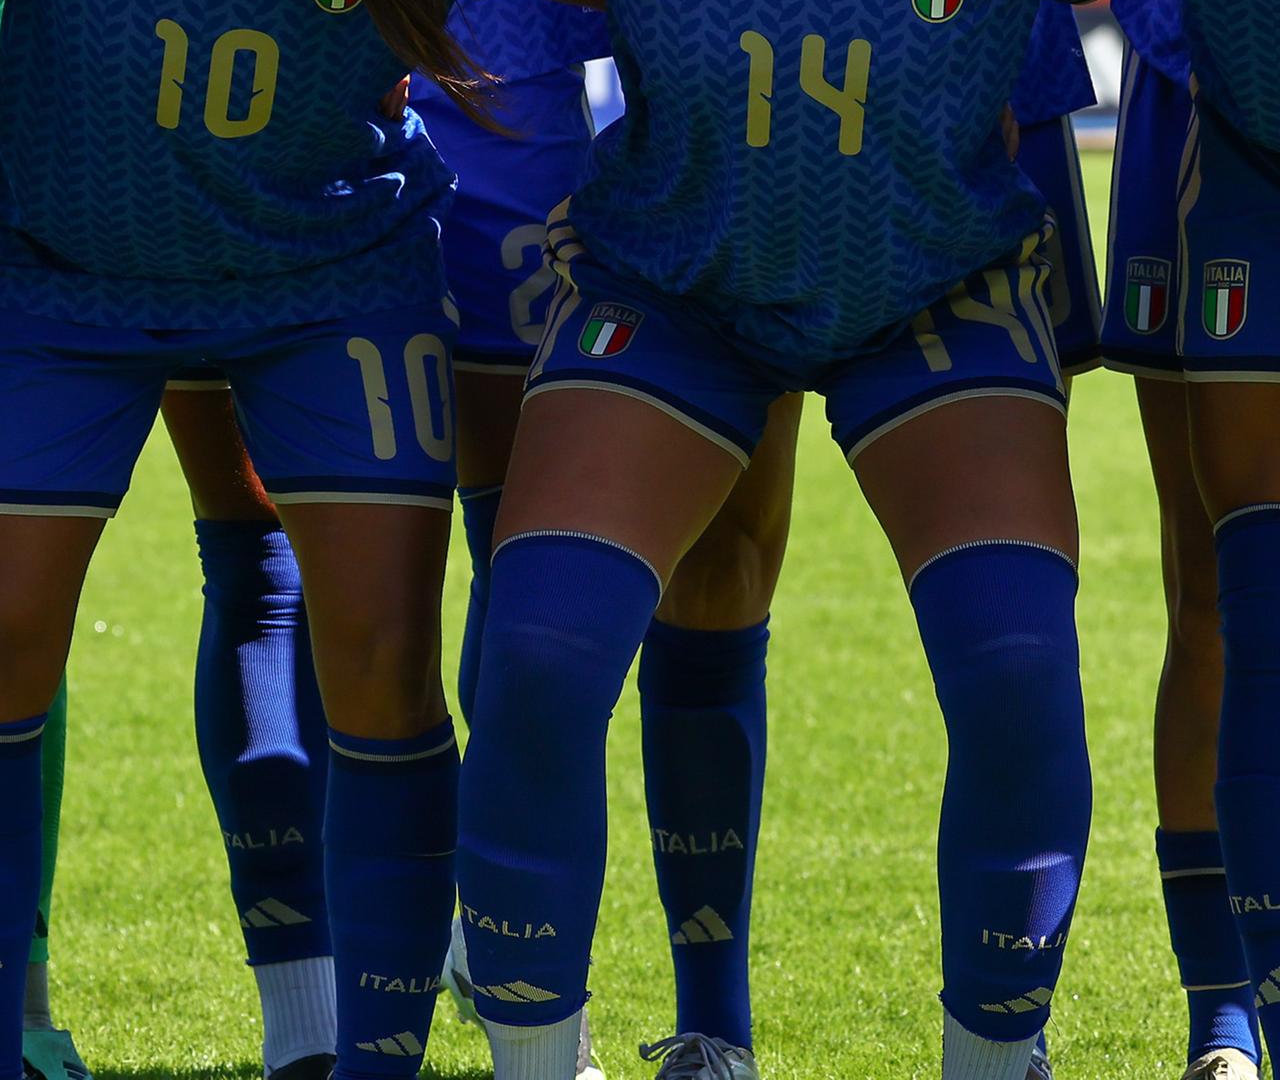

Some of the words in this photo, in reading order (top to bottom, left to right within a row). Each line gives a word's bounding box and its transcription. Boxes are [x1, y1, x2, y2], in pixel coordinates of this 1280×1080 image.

[155, 19, 279, 138] 10
[740, 30, 872, 155] 14
[1129, 262, 1166, 280] ITALIA
[1206, 266, 1244, 281] ITALIA
[592, 305, 638, 324] ITALIA
[347, 333, 452, 463] 10
[224, 826, 304, 849] TALIA
[982, 929, 1066, 950] ITALI
